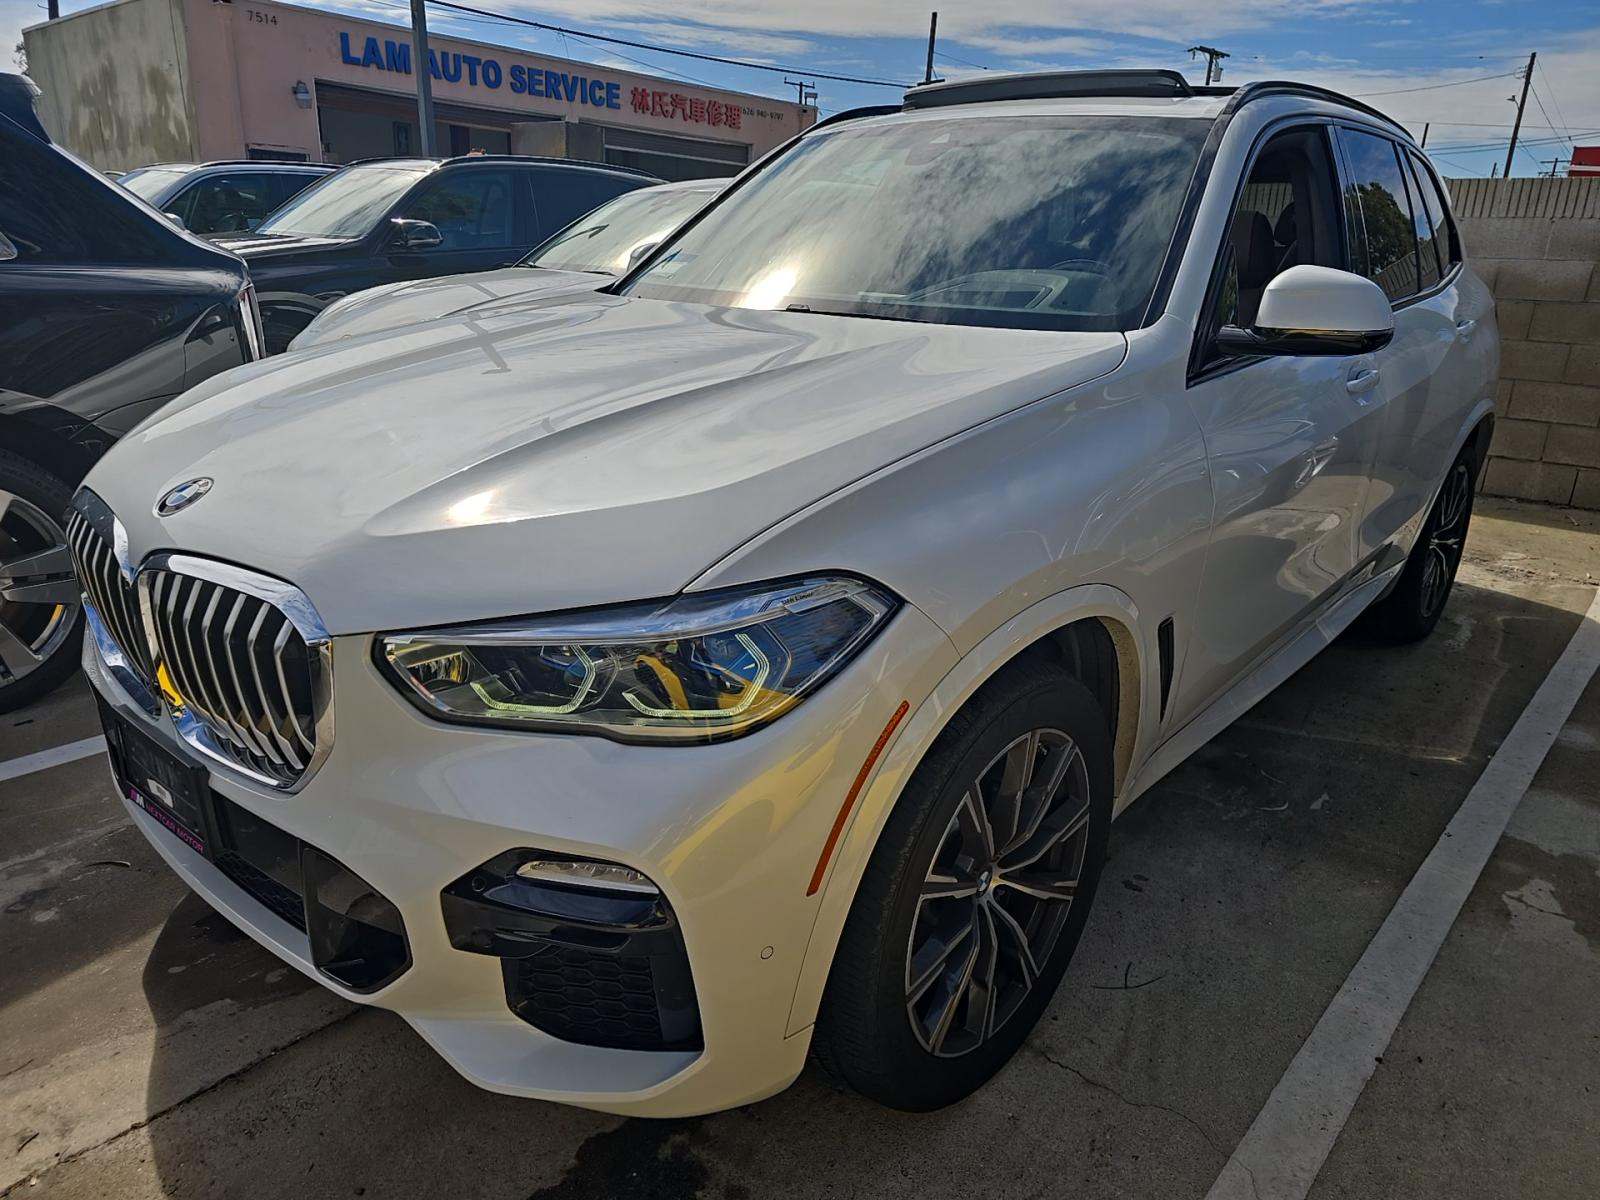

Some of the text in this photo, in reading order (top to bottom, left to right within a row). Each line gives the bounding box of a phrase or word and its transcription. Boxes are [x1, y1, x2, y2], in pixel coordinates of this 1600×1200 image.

[245, 10, 278, 26] 7514
[339, 32, 621, 110] LAM AUTO SERVICE
